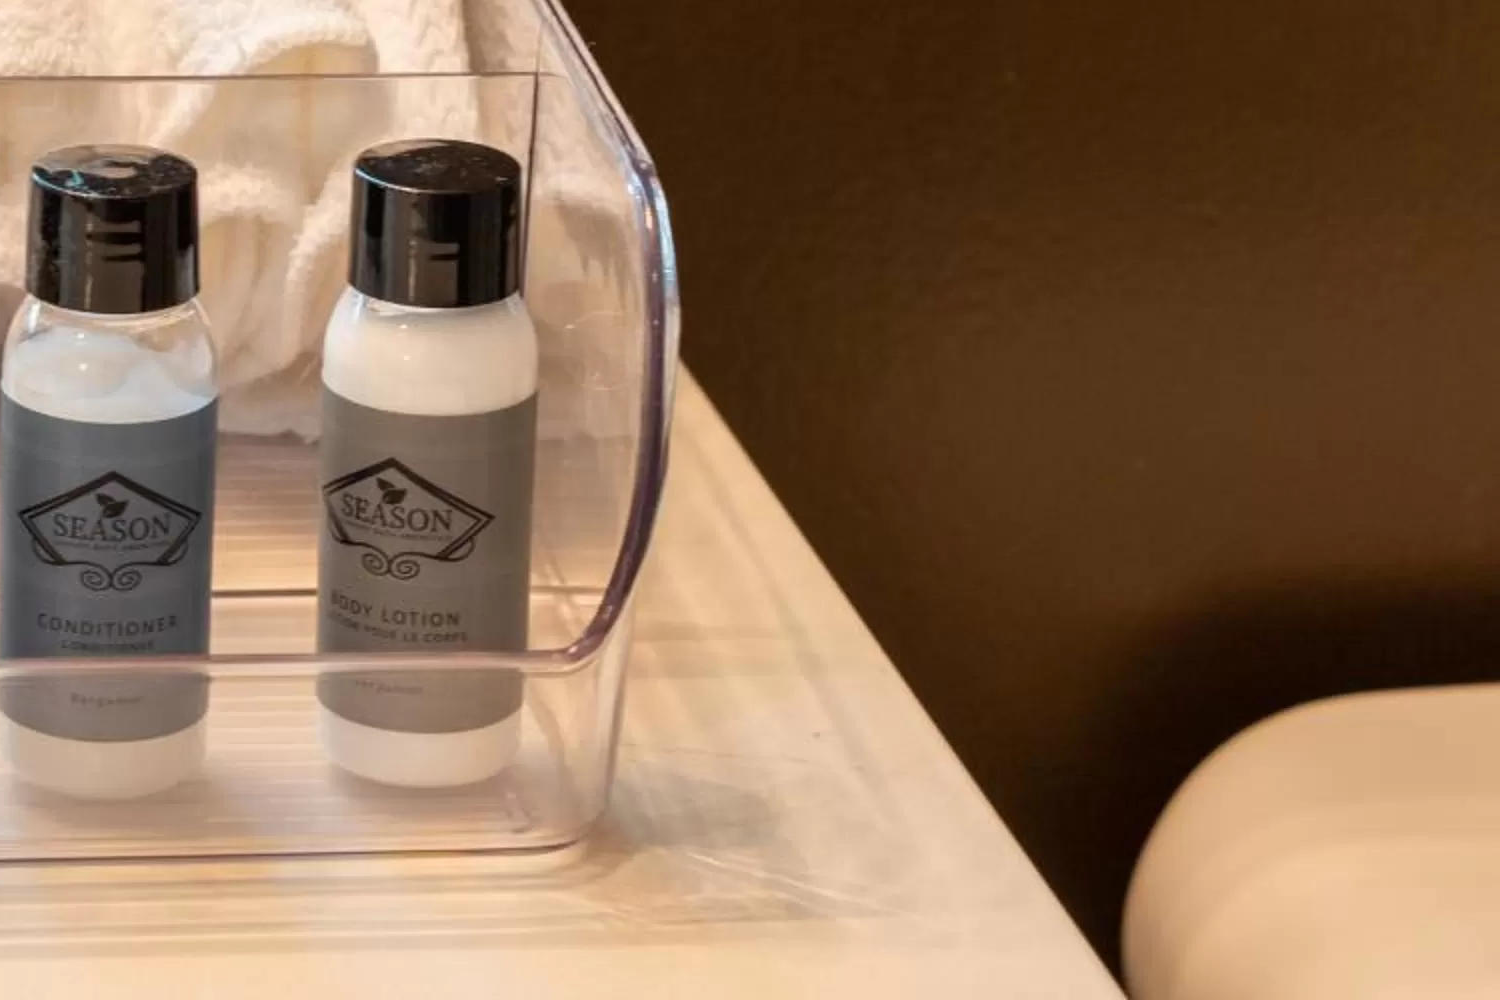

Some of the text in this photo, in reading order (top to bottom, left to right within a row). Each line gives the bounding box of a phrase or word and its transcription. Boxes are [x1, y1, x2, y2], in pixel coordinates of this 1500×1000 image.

[52, 511, 173, 542] SEASON
[342, 493, 454, 533] SEASON
[37, 612, 178, 637] CONDITIONER
[380, 606, 462, 628] LOTION
